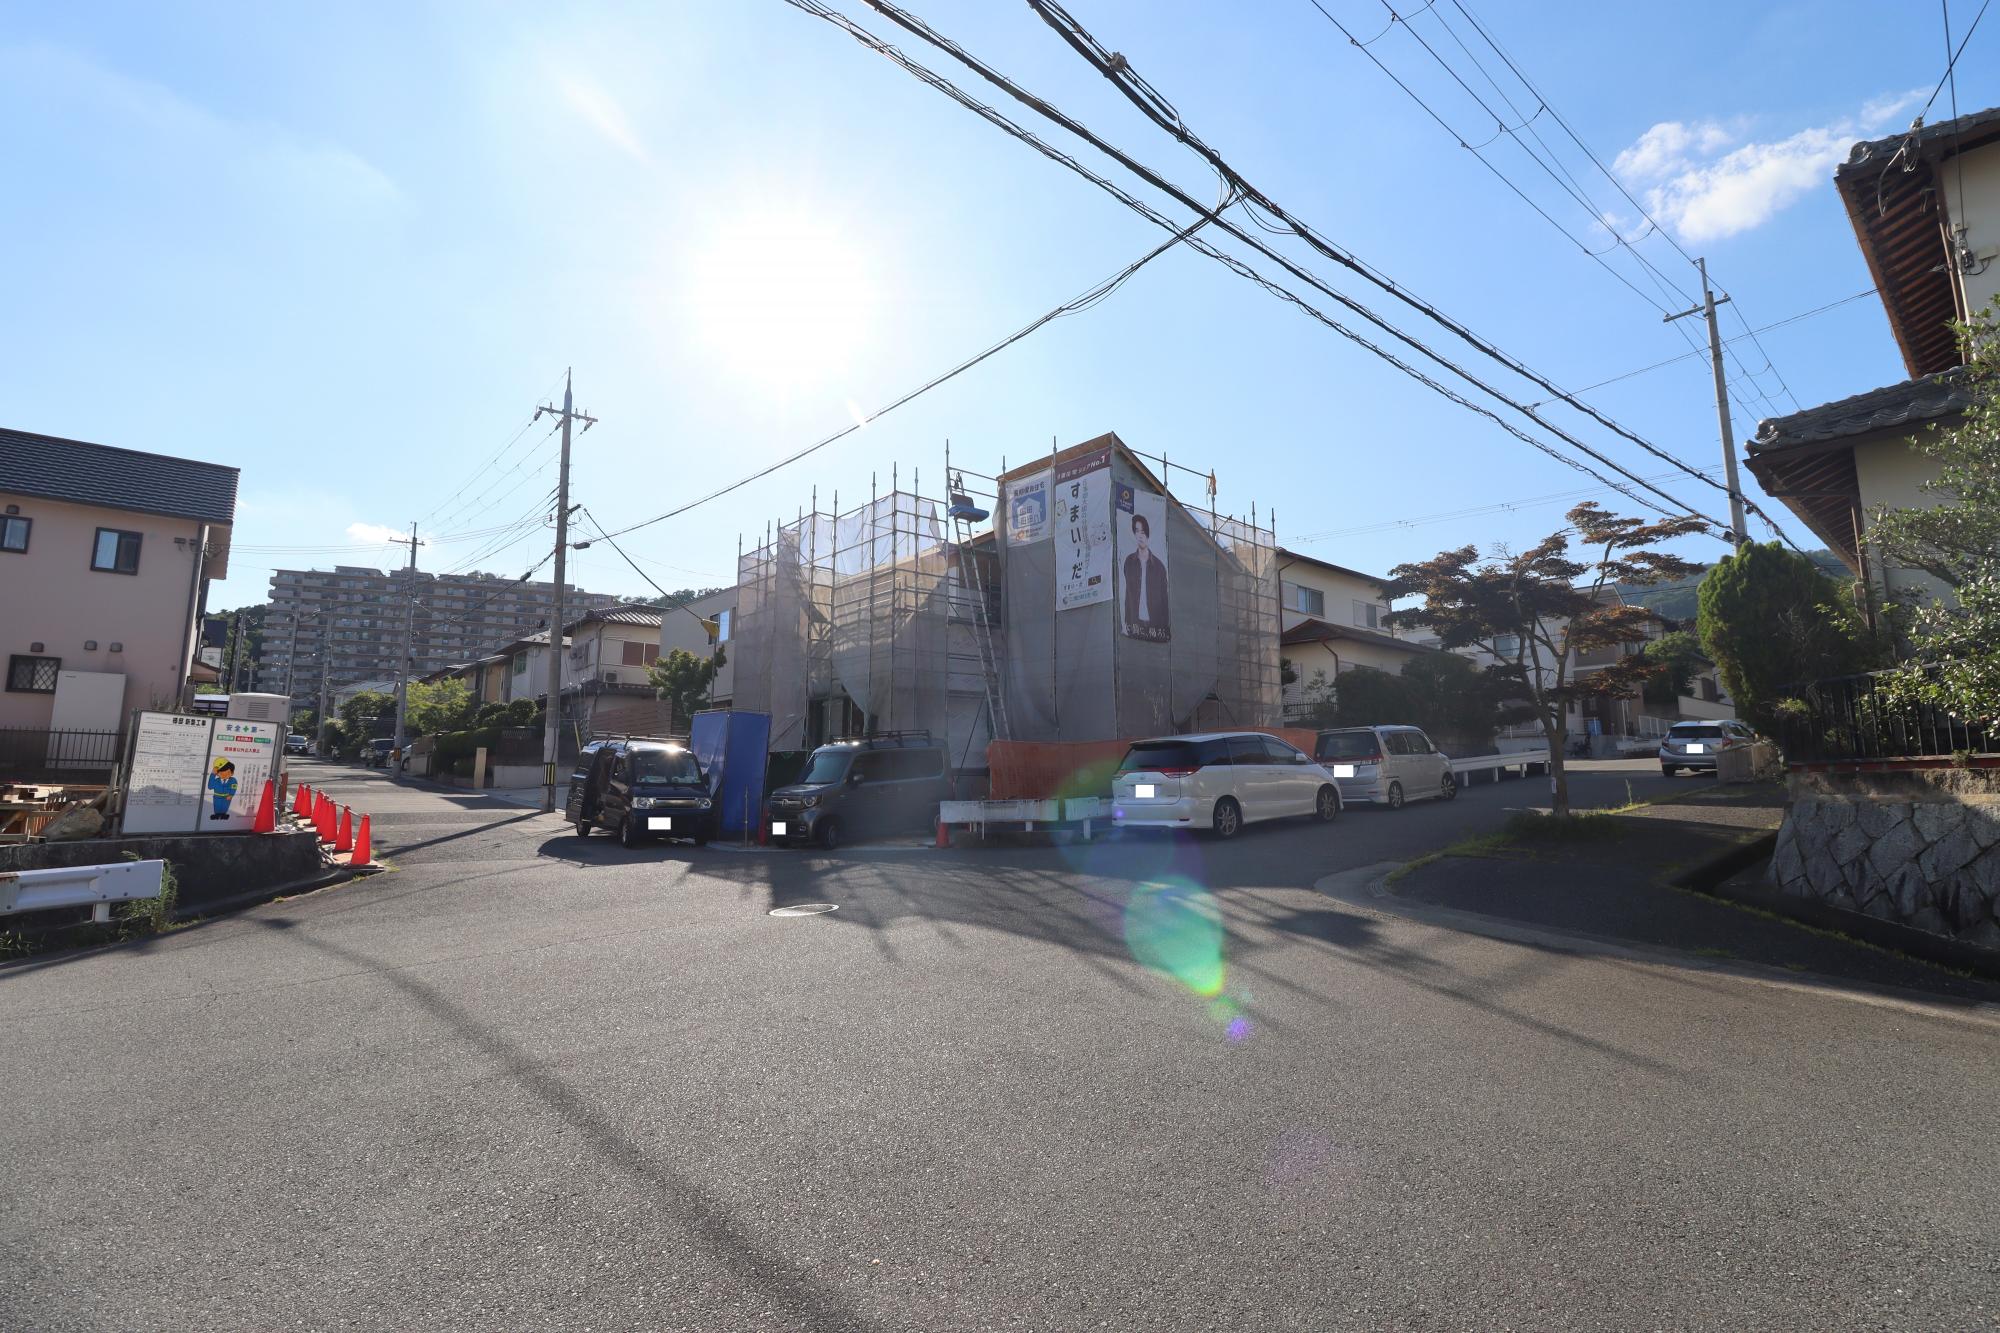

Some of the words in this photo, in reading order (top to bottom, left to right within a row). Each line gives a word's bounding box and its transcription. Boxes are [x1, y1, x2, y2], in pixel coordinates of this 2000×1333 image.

[1069, 481, 1084, 580] すまいーだ
